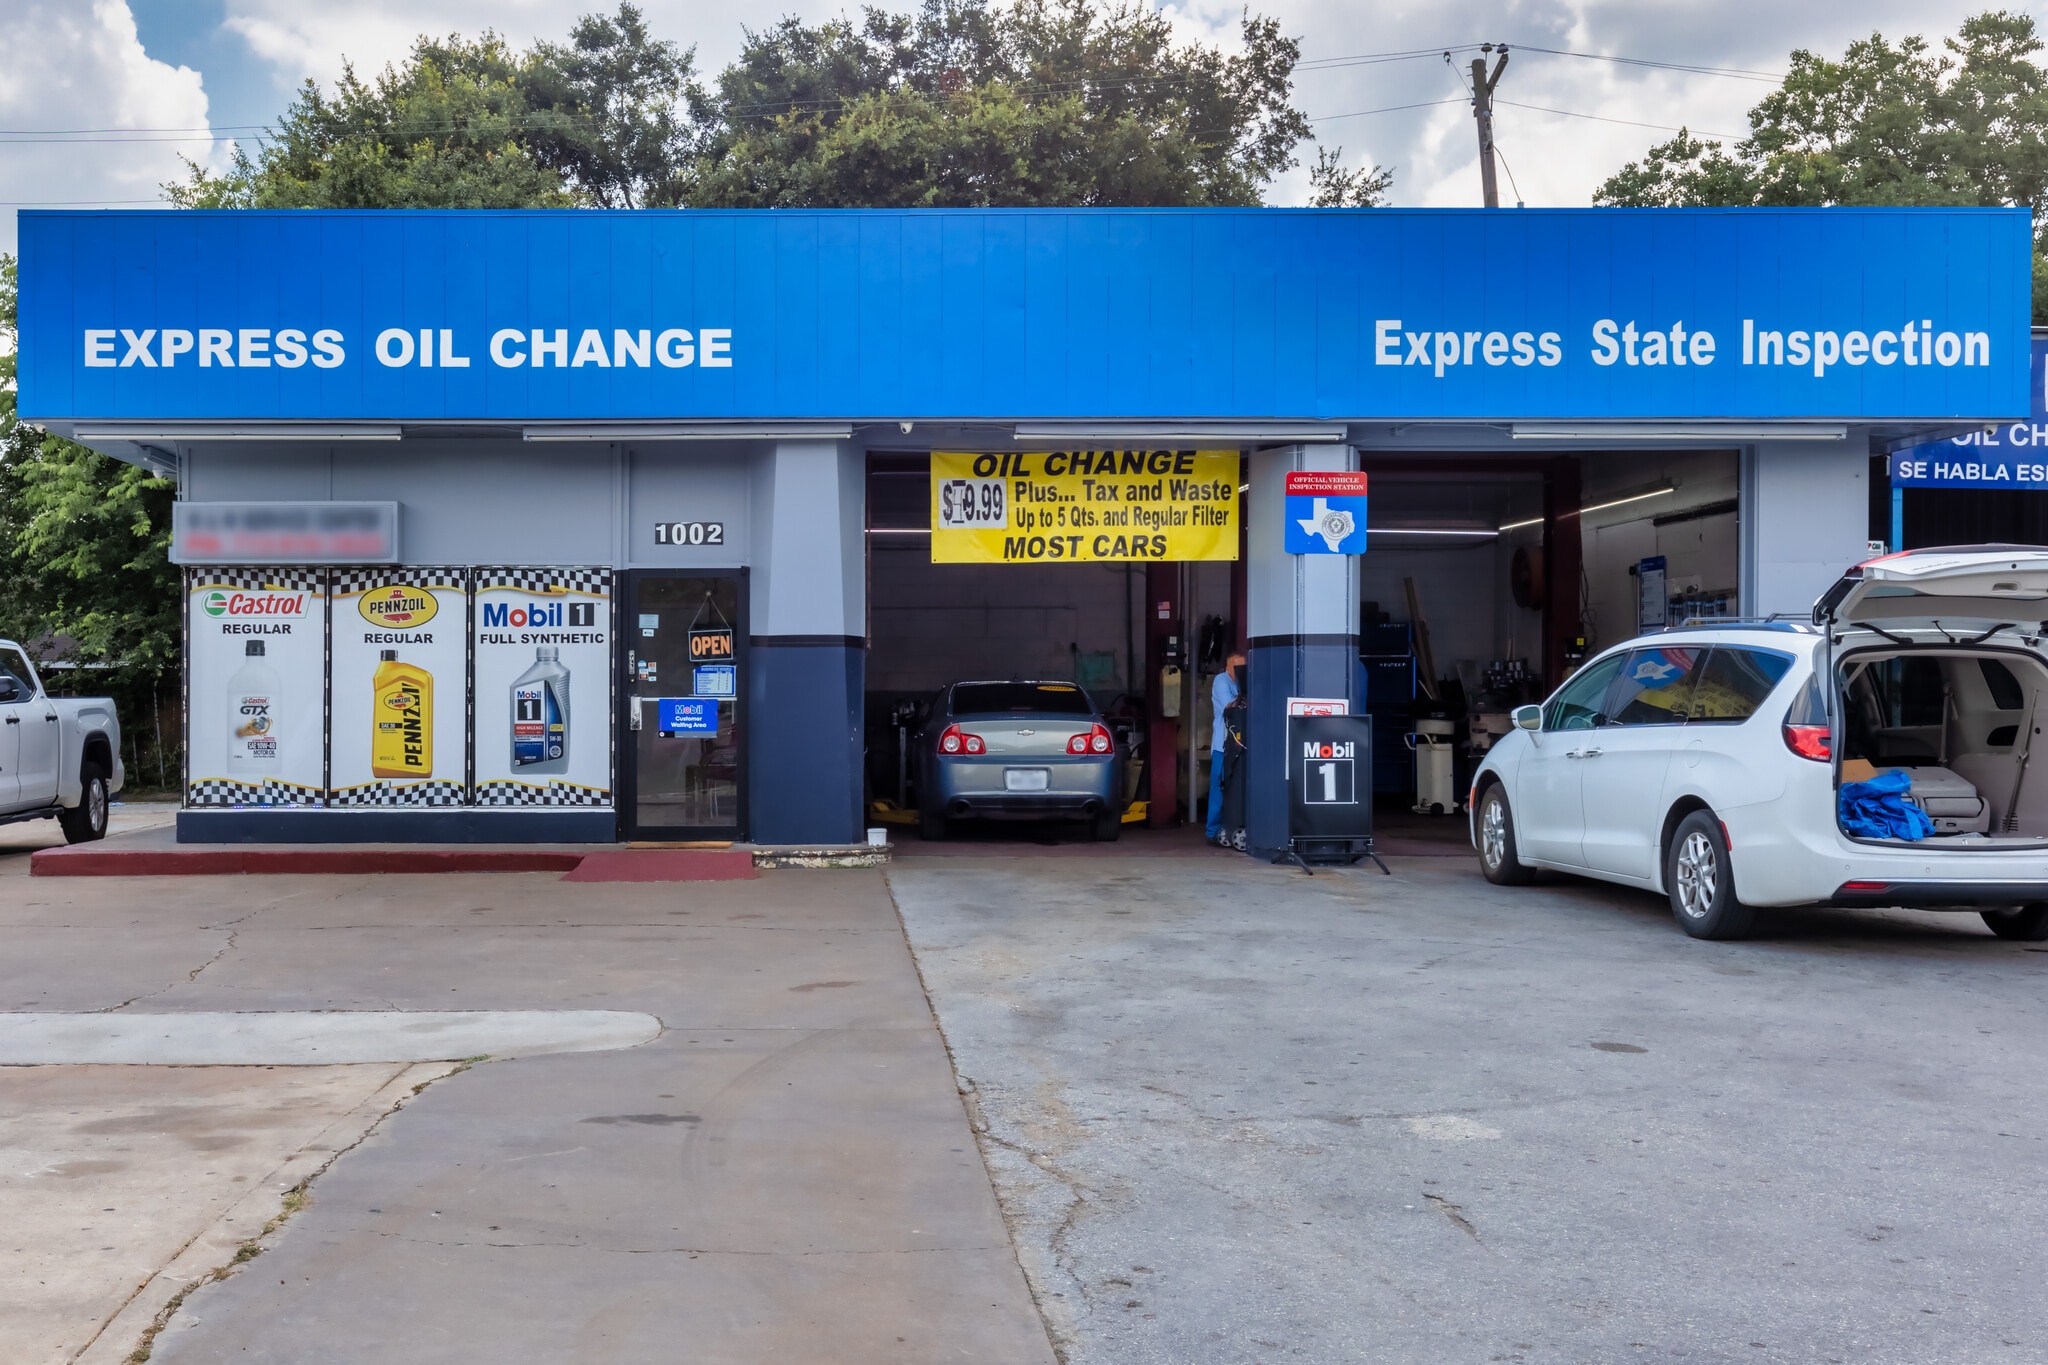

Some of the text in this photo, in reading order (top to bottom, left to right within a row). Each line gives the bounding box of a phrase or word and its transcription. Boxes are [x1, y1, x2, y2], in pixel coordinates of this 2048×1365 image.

[84, 329, 733, 368] EXPRESS OIL CHANGE
[1375, 318, 1990, 378] Express State Inspection
[972, 450, 1197, 477] OIL CHANGE
[1899, 461, 2048, 482] SE HABLA ES
[1015, 478, 1232, 502] Plus... Tax and Waste
[943, 481, 1003, 526] $9.99
[1016, 505, 1229, 532] Up to 5 Qts. and Regular Filter
[656, 523, 723, 545] 1002
[1003, 535, 1167, 558] MOST CARS
[228, 593, 303, 615] Castrol
[369, 597, 426, 614] PENNZOIL
[483, 602, 562, 627] Mobil
[222, 624, 292, 634] REGULAR
[364, 633, 434, 644] REGULAR
[480, 633, 605, 644] FULL SYNTHETIC
[691, 635, 731, 656] OPEN
[517, 691, 542, 699] Mobil
[240, 705, 270, 716] GTX
[675, 704, 704, 715] Mobil
[1303, 741, 1355, 759] Mobil
[1318, 762, 1337, 802] 1
